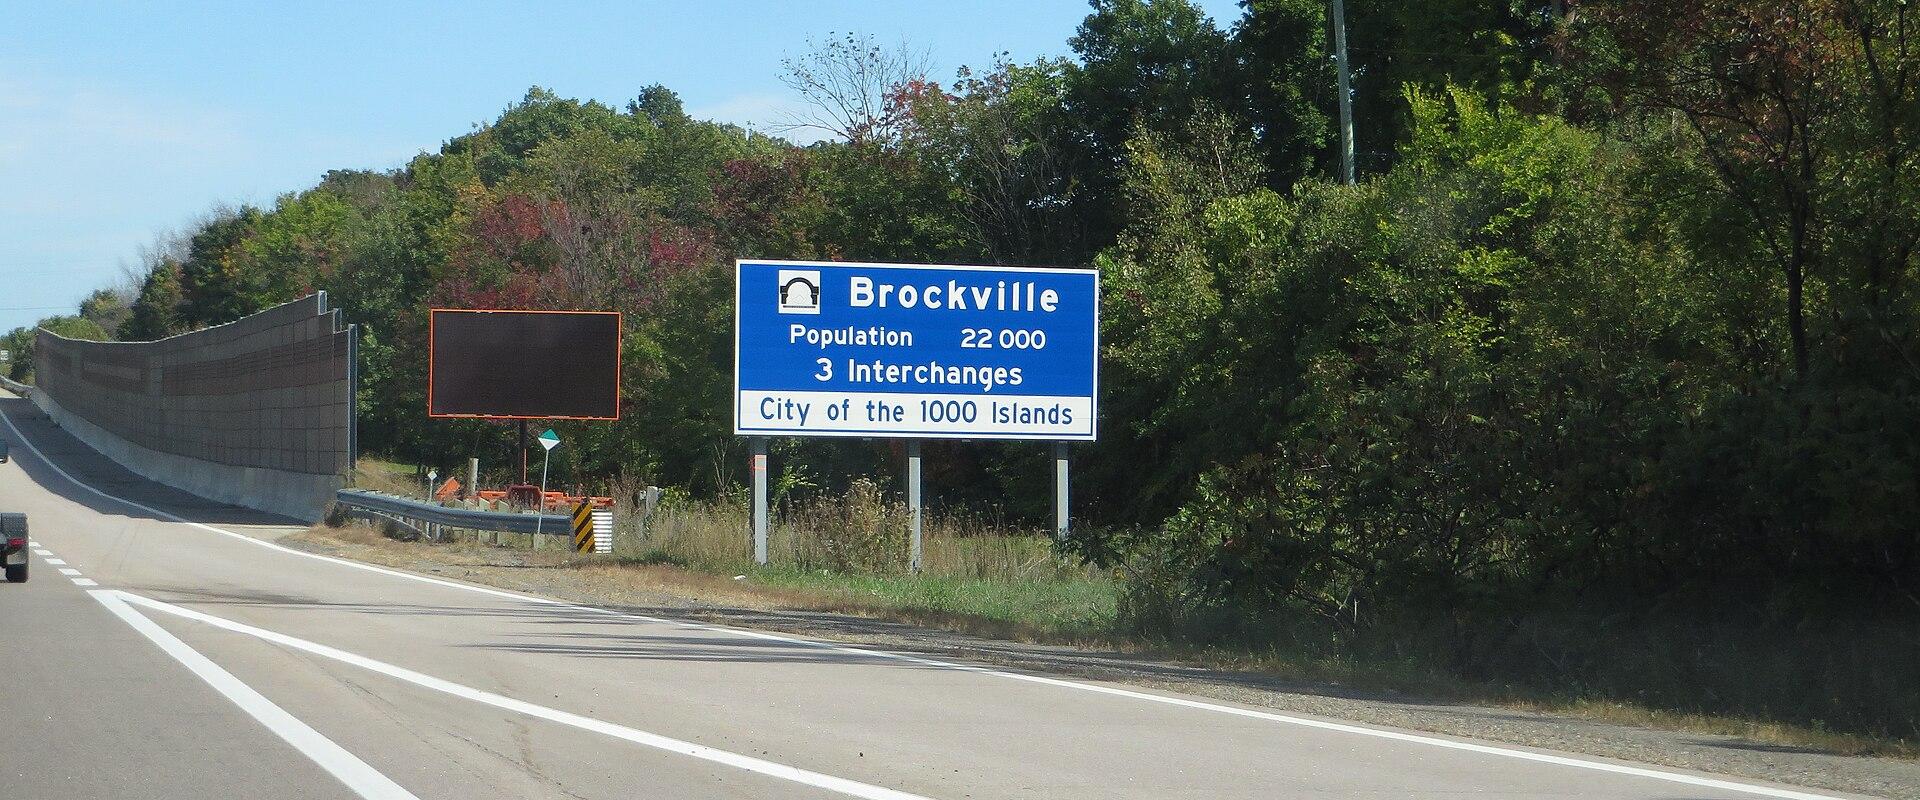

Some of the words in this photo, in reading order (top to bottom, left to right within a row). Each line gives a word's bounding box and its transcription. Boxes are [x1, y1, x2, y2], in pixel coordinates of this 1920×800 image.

[850, 277, 1059, 312] Brockville
[790, 324, 913, 349] Population
[960, 328, 992, 348] 22
[999, 329, 1046, 350] 000
[814, 358, 833, 381] 3
[849, 359, 1023, 392] Interchanges
[760, 397, 811, 426] City
[828, 399, 850, 421] of
[866, 401, 905, 422] the
[921, 401, 977, 423] 1000
[992, 402, 1073, 425] Islands
